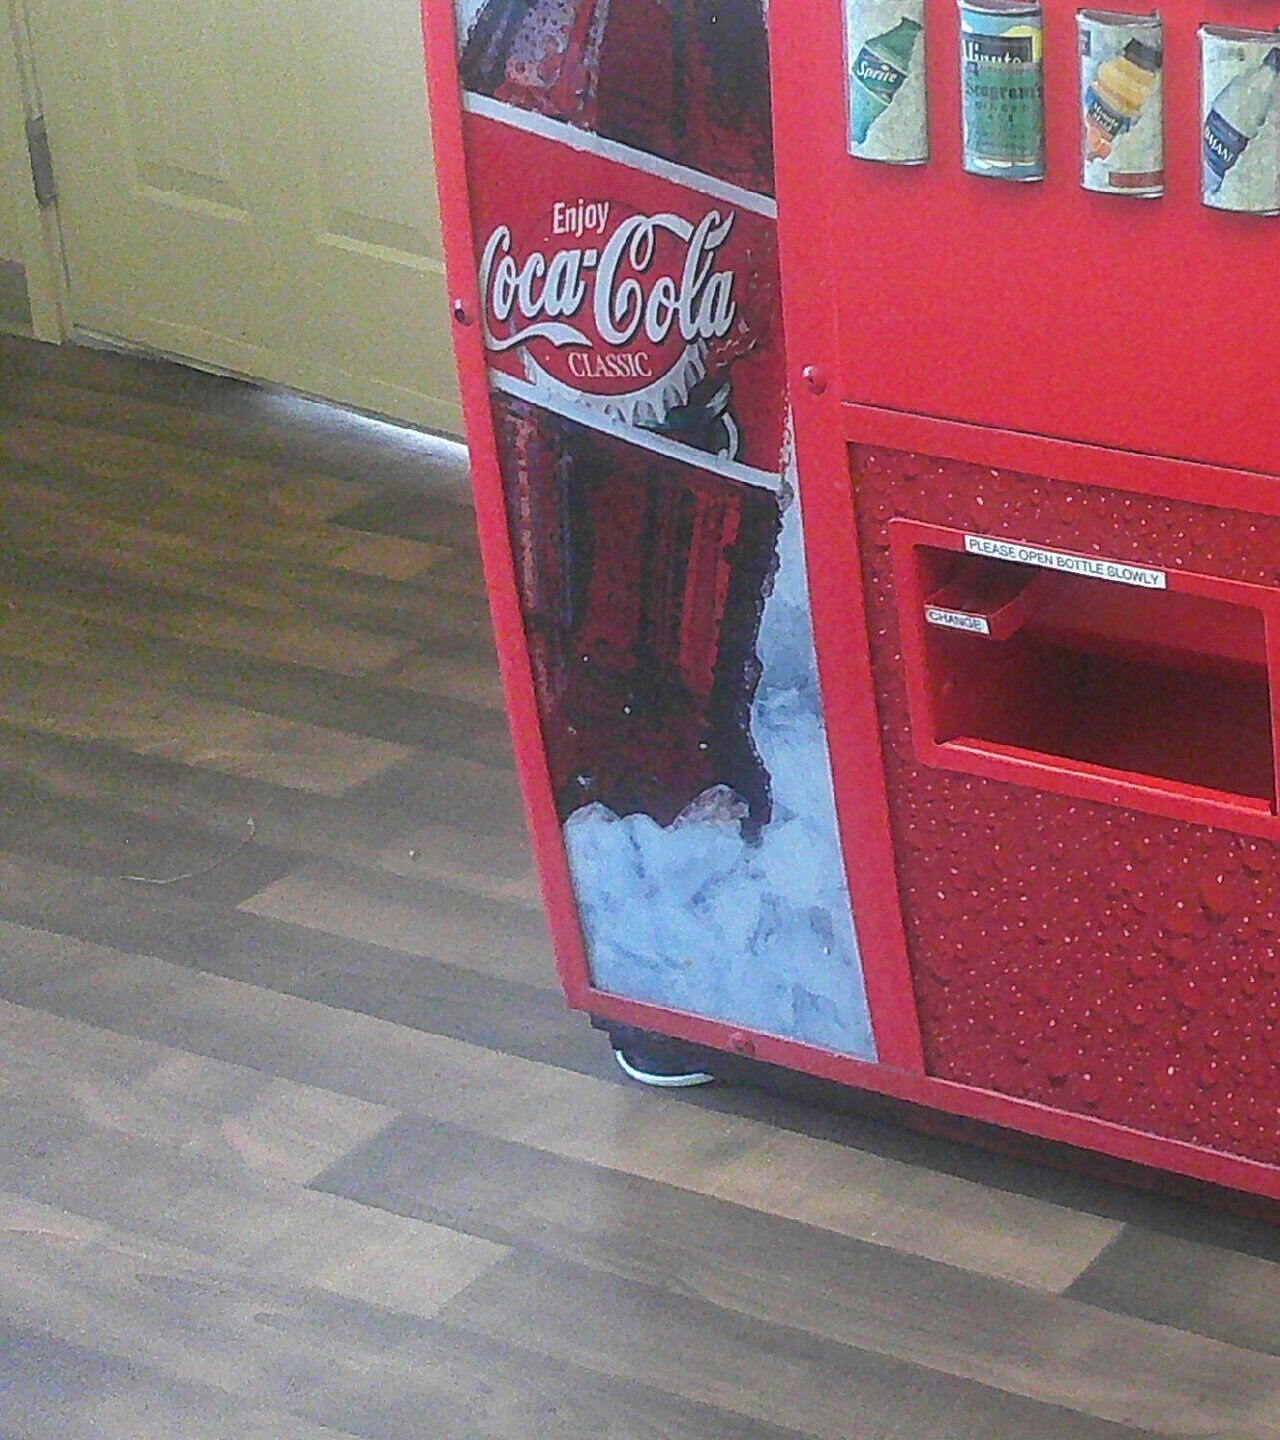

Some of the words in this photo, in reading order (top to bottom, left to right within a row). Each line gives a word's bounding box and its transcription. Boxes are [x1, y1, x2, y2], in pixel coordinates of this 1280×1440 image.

[856, 59, 898, 84] Sprite
[552, 198, 610, 238] Enjoy
[479, 210, 736, 351] Coca-Cola
[568, 351, 653, 378] CLASSIC
[968, 538, 1017, 559] PLEASE
[1018, 549, 1054, 566] OPEN
[1056, 555, 1104, 575] BOTTLE
[1107, 564, 1161, 585] SLOWLY
[929, 610, 983, 631] CHANGE
